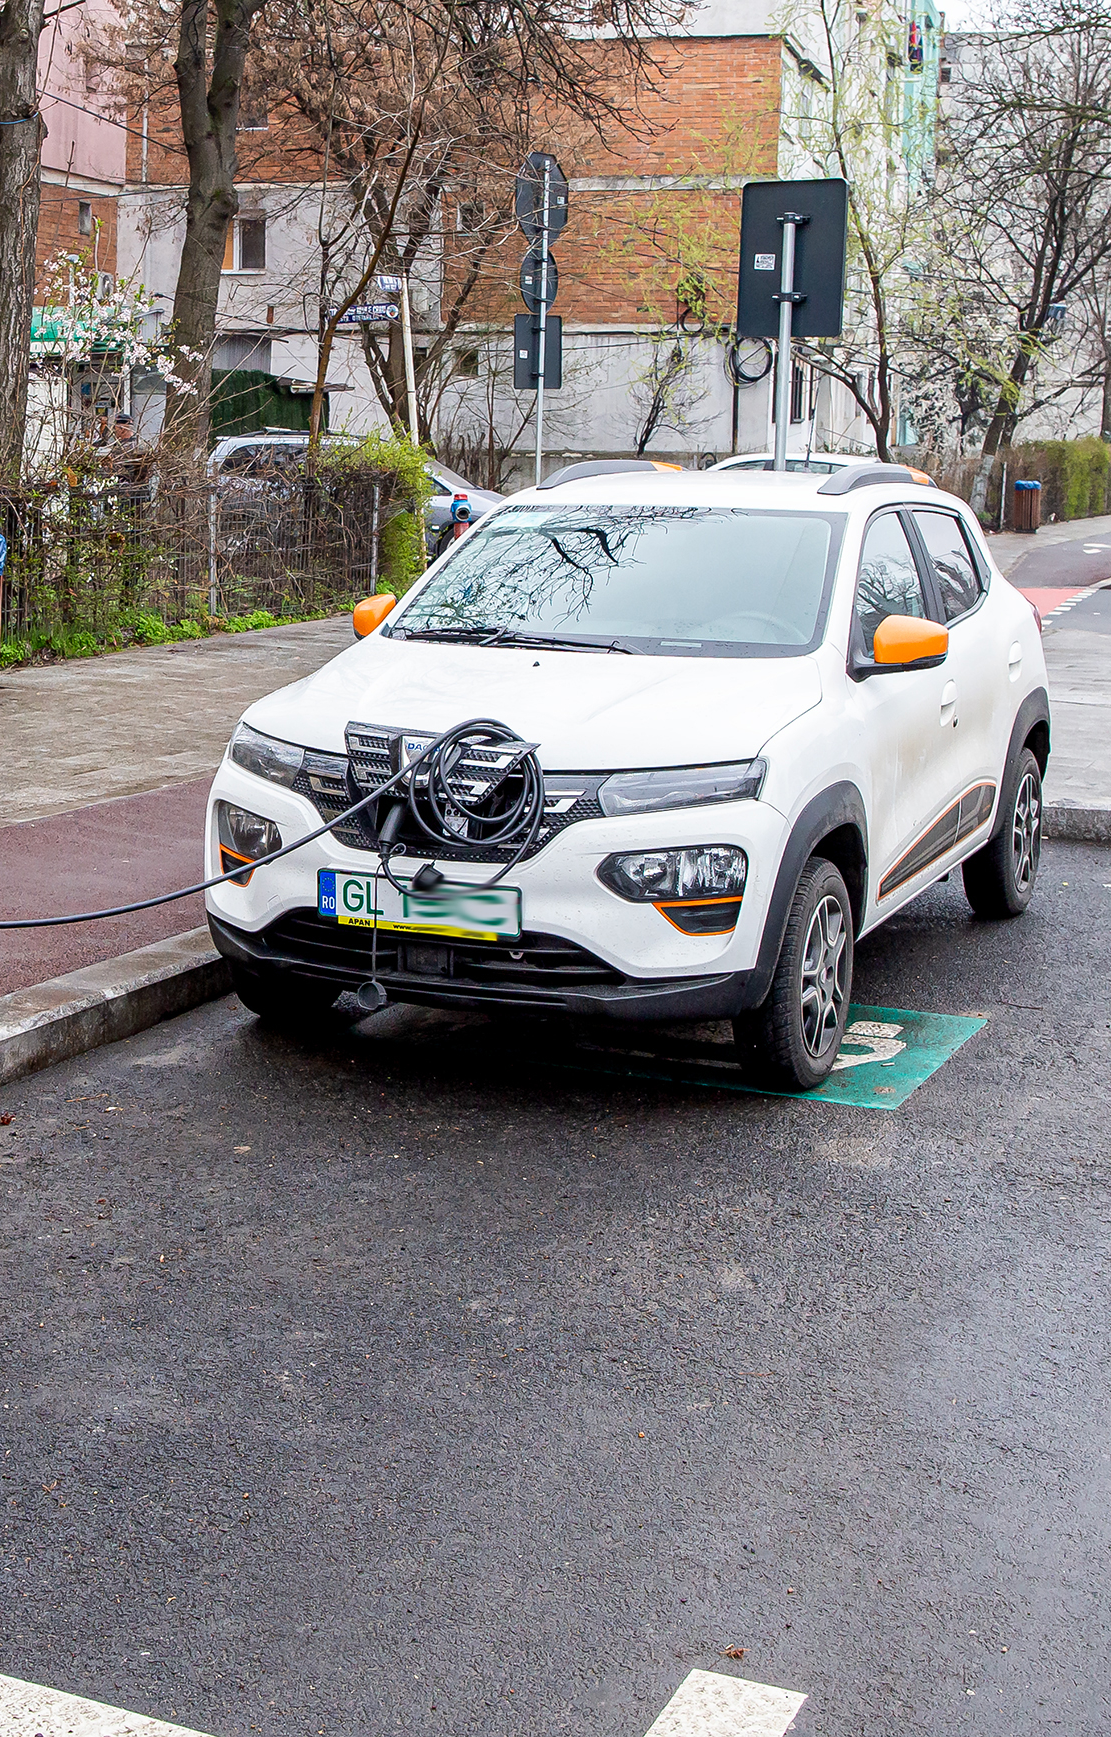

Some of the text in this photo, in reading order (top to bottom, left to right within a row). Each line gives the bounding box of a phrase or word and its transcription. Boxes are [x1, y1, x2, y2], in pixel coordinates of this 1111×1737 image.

[322, 895, 335, 910] RO
[342, 880, 384, 915] GL
[348, 917, 370, 927] APAN
